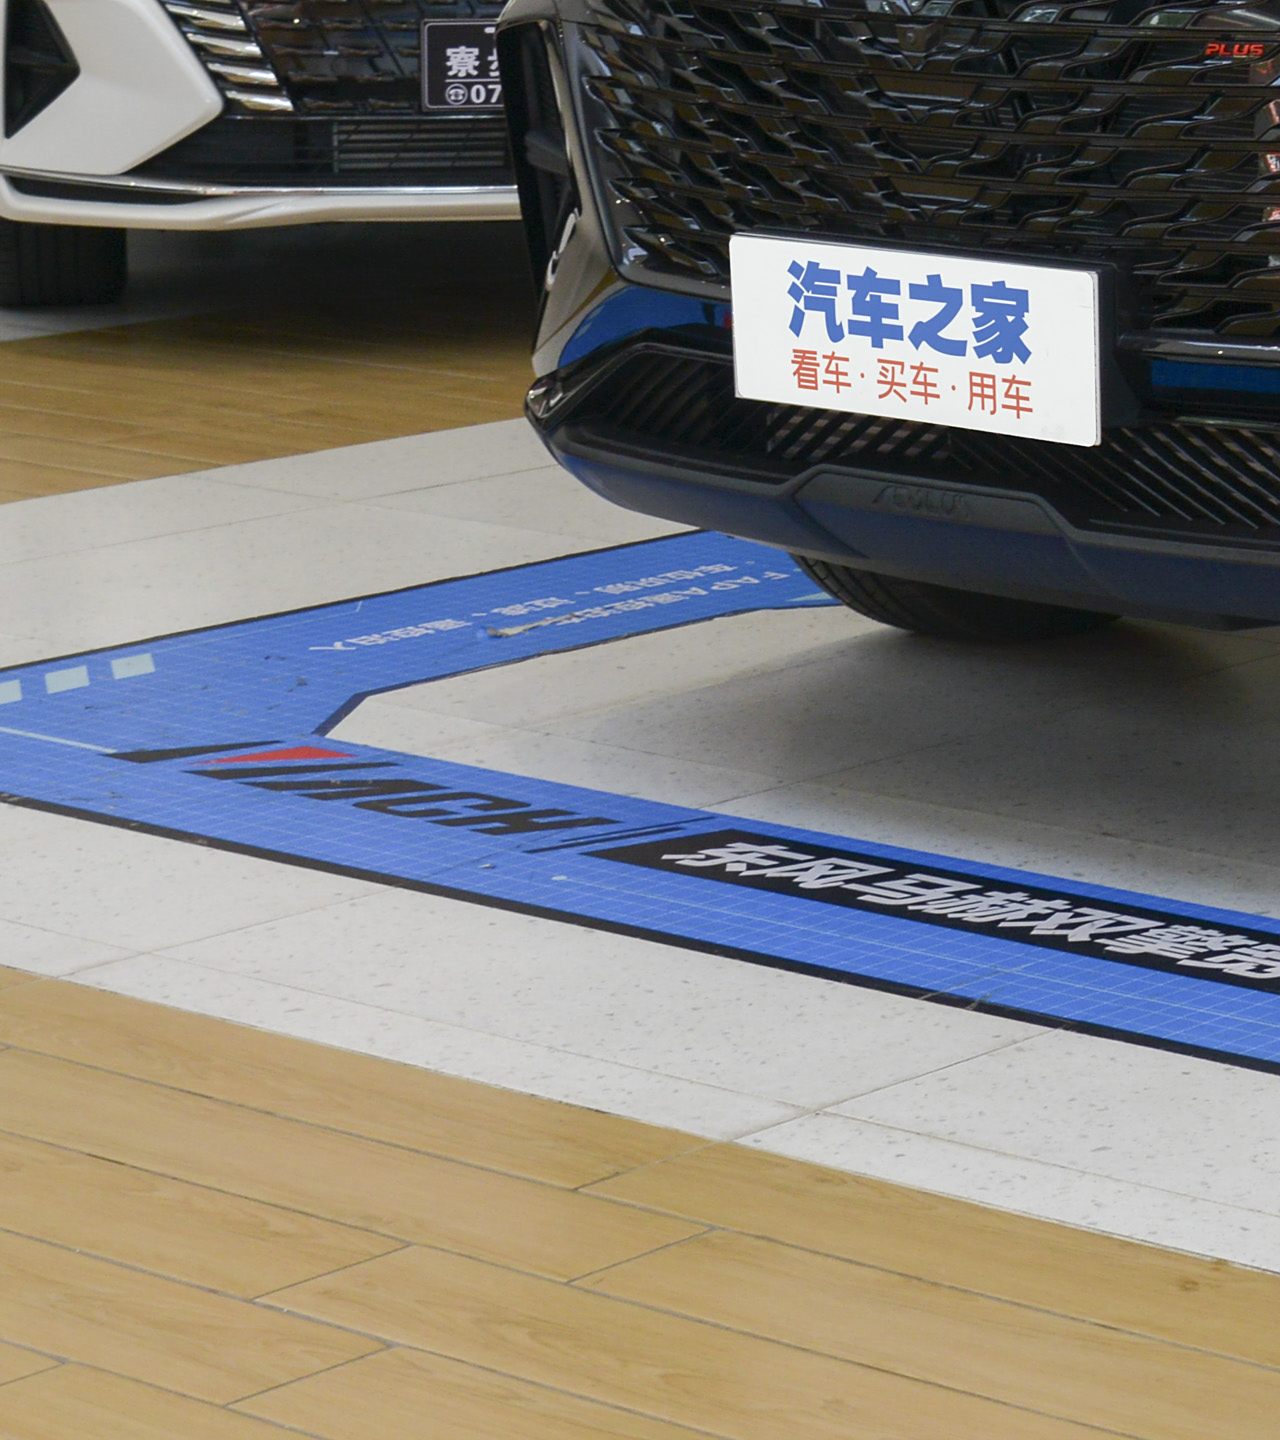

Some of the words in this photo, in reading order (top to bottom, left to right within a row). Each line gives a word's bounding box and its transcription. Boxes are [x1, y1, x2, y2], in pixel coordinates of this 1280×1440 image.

[1205, 42, 1264, 57] PLUS
[786, 260, 1032, 364] 汽车之家
